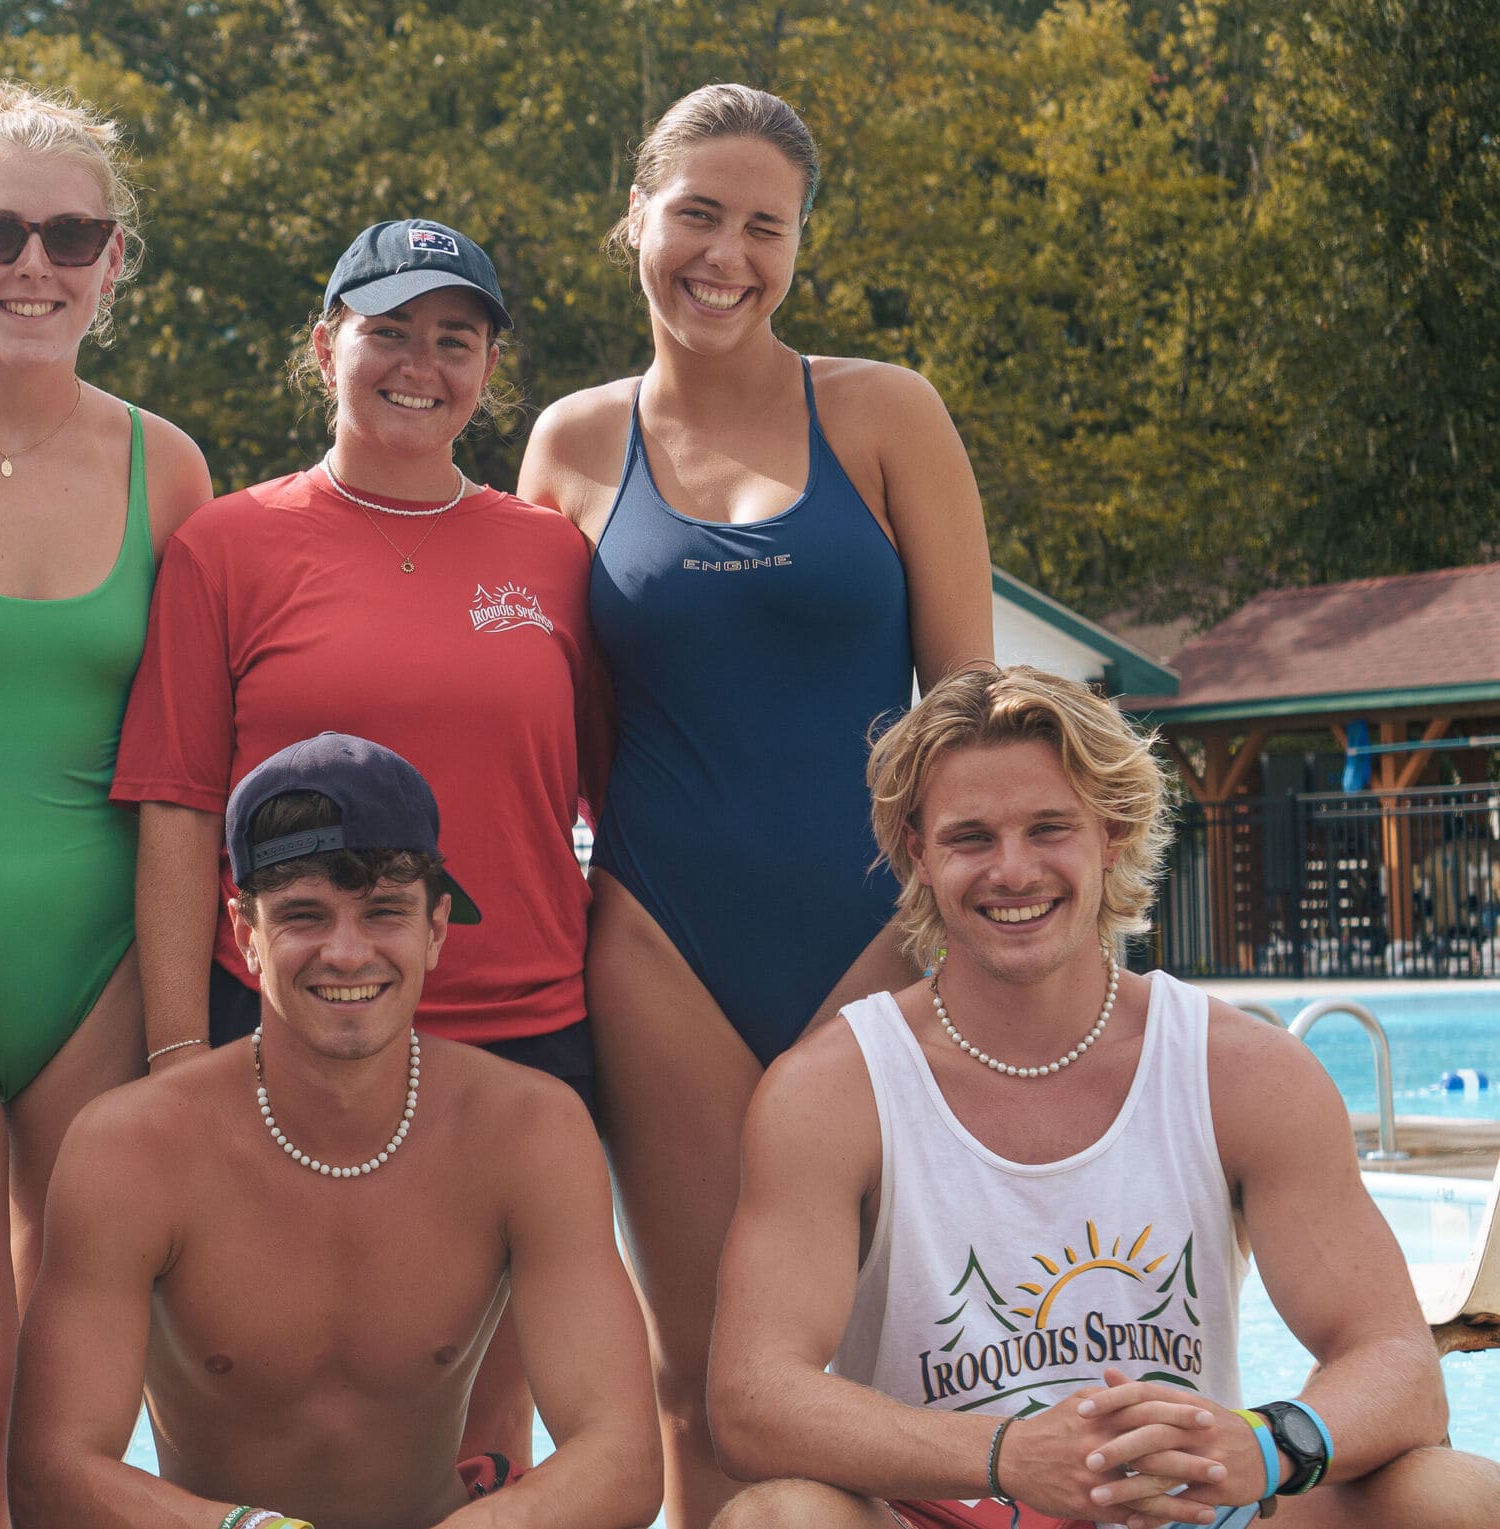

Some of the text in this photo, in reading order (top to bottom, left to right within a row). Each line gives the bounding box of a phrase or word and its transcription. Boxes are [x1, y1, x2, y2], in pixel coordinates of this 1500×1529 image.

[683, 553, 792, 571] ENGINE
[469, 604, 515, 627] IROQUOIS
[918, 1310, 1203, 1405] IROQUOIS SPRINGS
